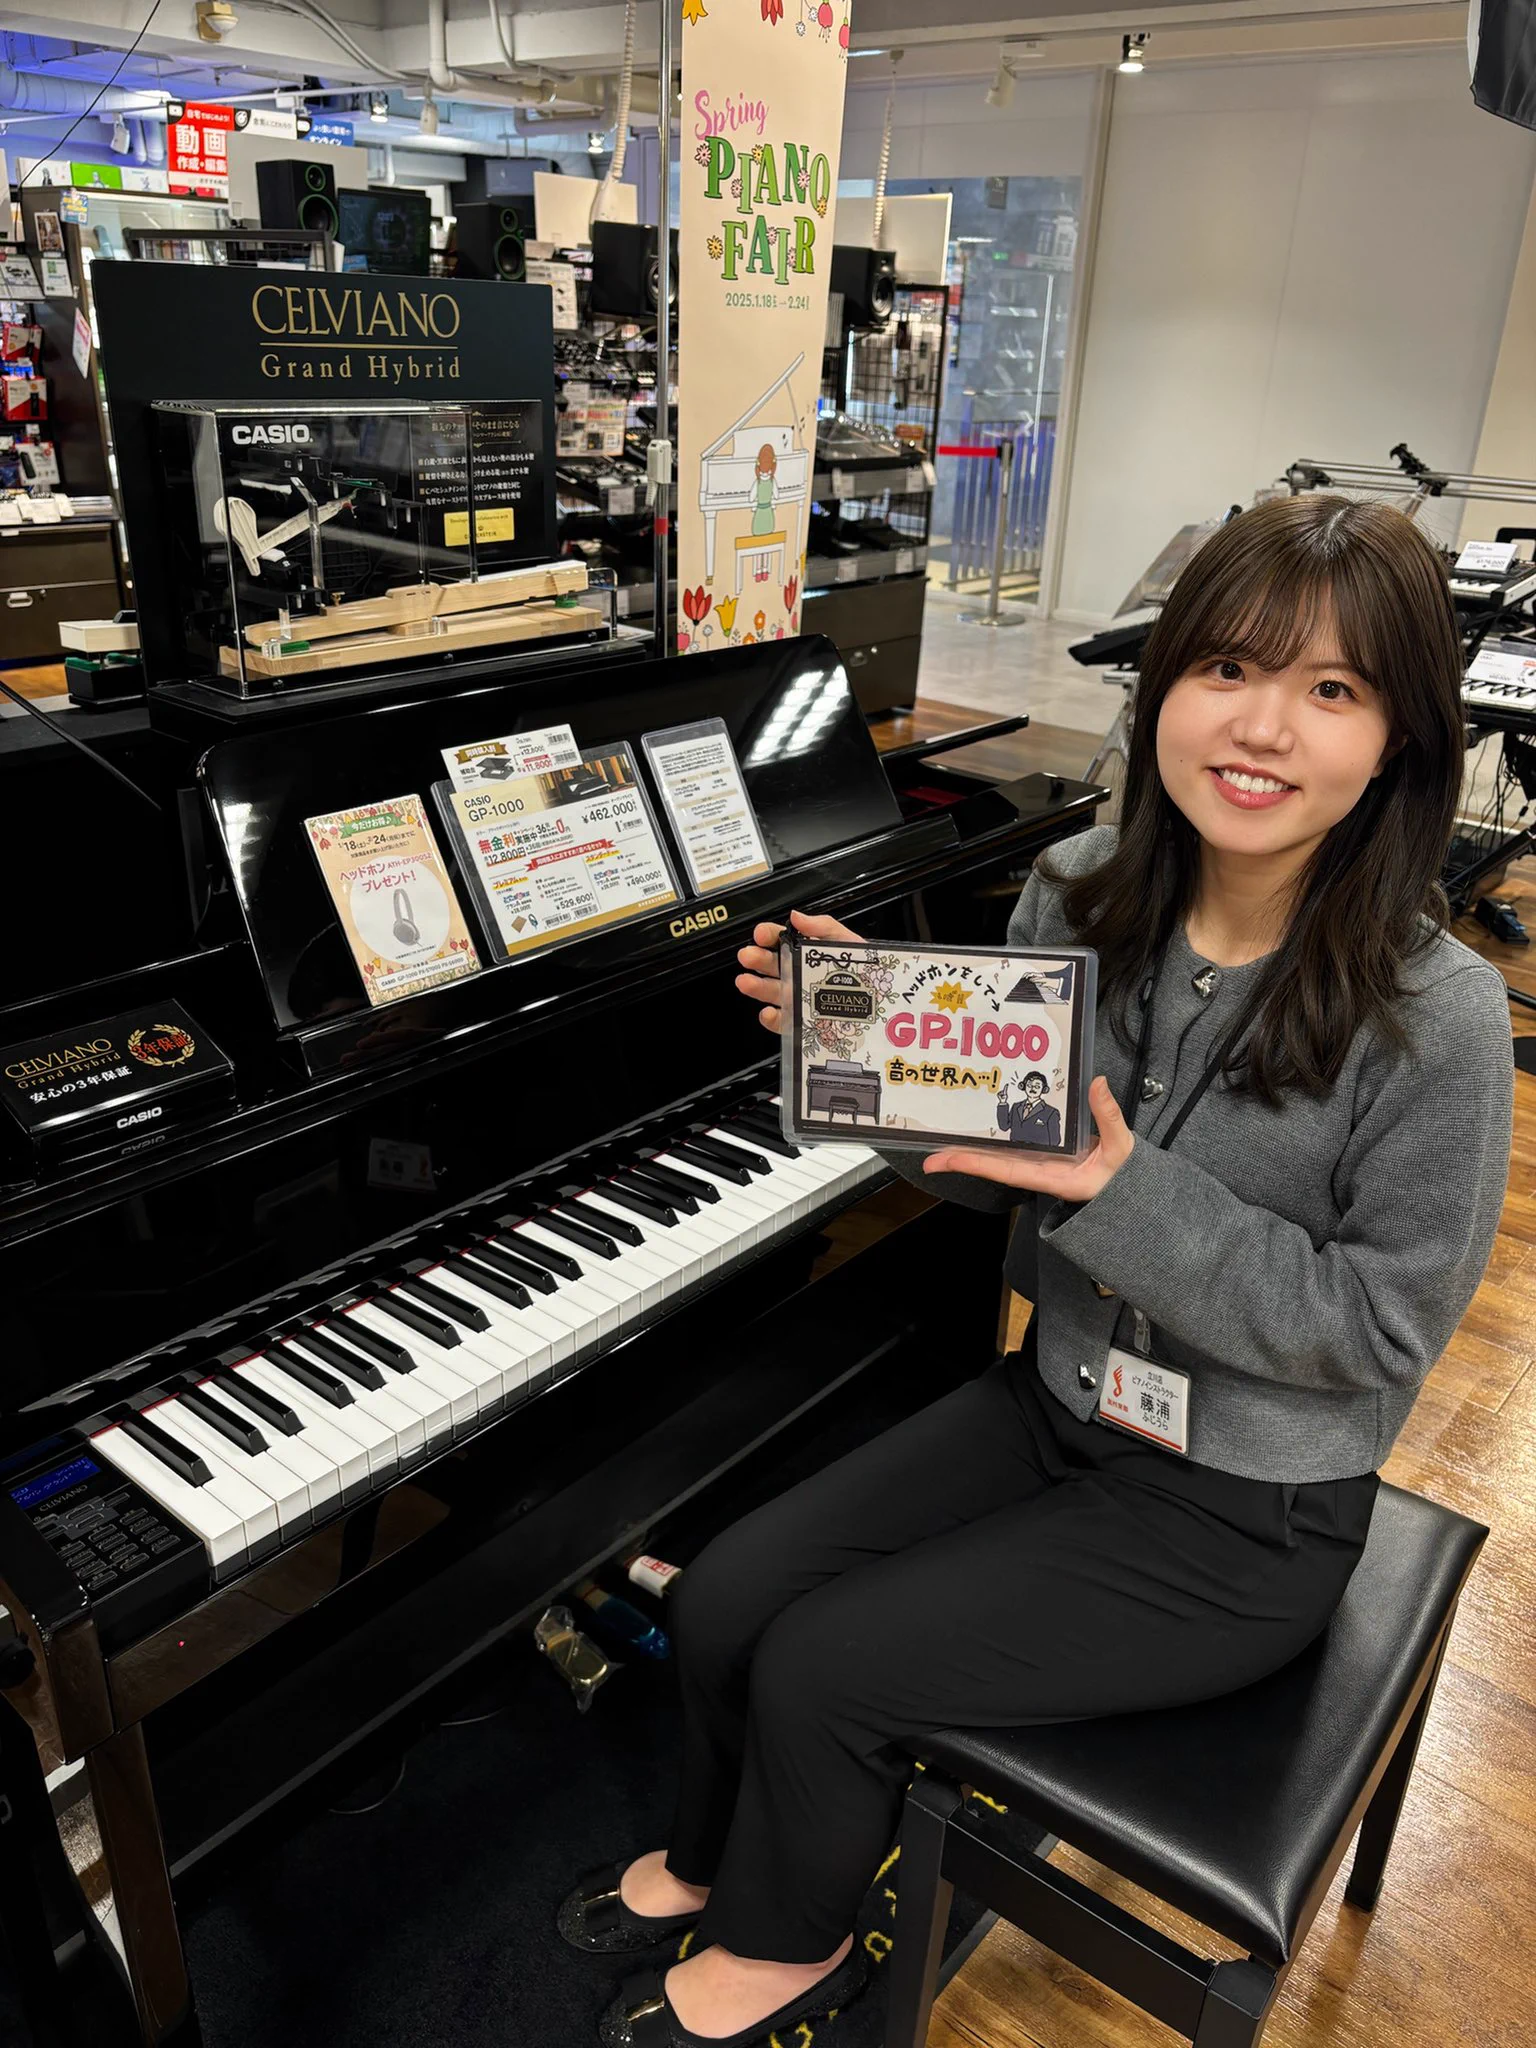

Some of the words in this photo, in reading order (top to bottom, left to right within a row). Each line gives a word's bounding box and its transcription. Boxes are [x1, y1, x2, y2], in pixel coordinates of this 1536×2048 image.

[694, 89, 769, 140] Spring
[175, 124, 227, 156] 動画
[704, 136, 830, 214] PIANO
[721, 215, 815, 285] FAIR
[252, 285, 460, 339] CELVIANO
[261, 354, 352, 378] Grand
[368, 355, 461, 385] Hybrid
[464, 795, 491, 808] CASIO
[468, 798, 525, 822] GP-1000
[581, 801, 634, 824] ¥462,000
[478, 831, 516, 854] 無金利
[515, 832, 538, 846] 実施中
[339, 863, 386, 882] ヘッドホン
[361, 870, 417, 893] プレゼント!
[556, 894, 591, 910] ¥529,600
[669, 905, 729, 938] CASIO
[902, 963, 997, 1004] ヘッドホンをして
[819, 993, 869, 1006] CELVIANO
[844, 1005, 868, 1013] Hybrid
[131, 1033, 190, 1060] 3年保証
[885, 1011, 1050, 1062] GP-1000
[4, 1038, 112, 1080] CELVIANO
[17, 1069, 64, 1090] Grand
[70, 1052, 121, 1074] Hybrid
[29, 1065, 132, 1105] 安心の3年保証
[117, 1107, 163, 1129] CASIO
[1132, 1375, 1179, 1400] ピアノインストラクター
[1140, 1391, 1170, 1421] 藤浦
[1142, 1412, 1169, 1431] ふじうら
